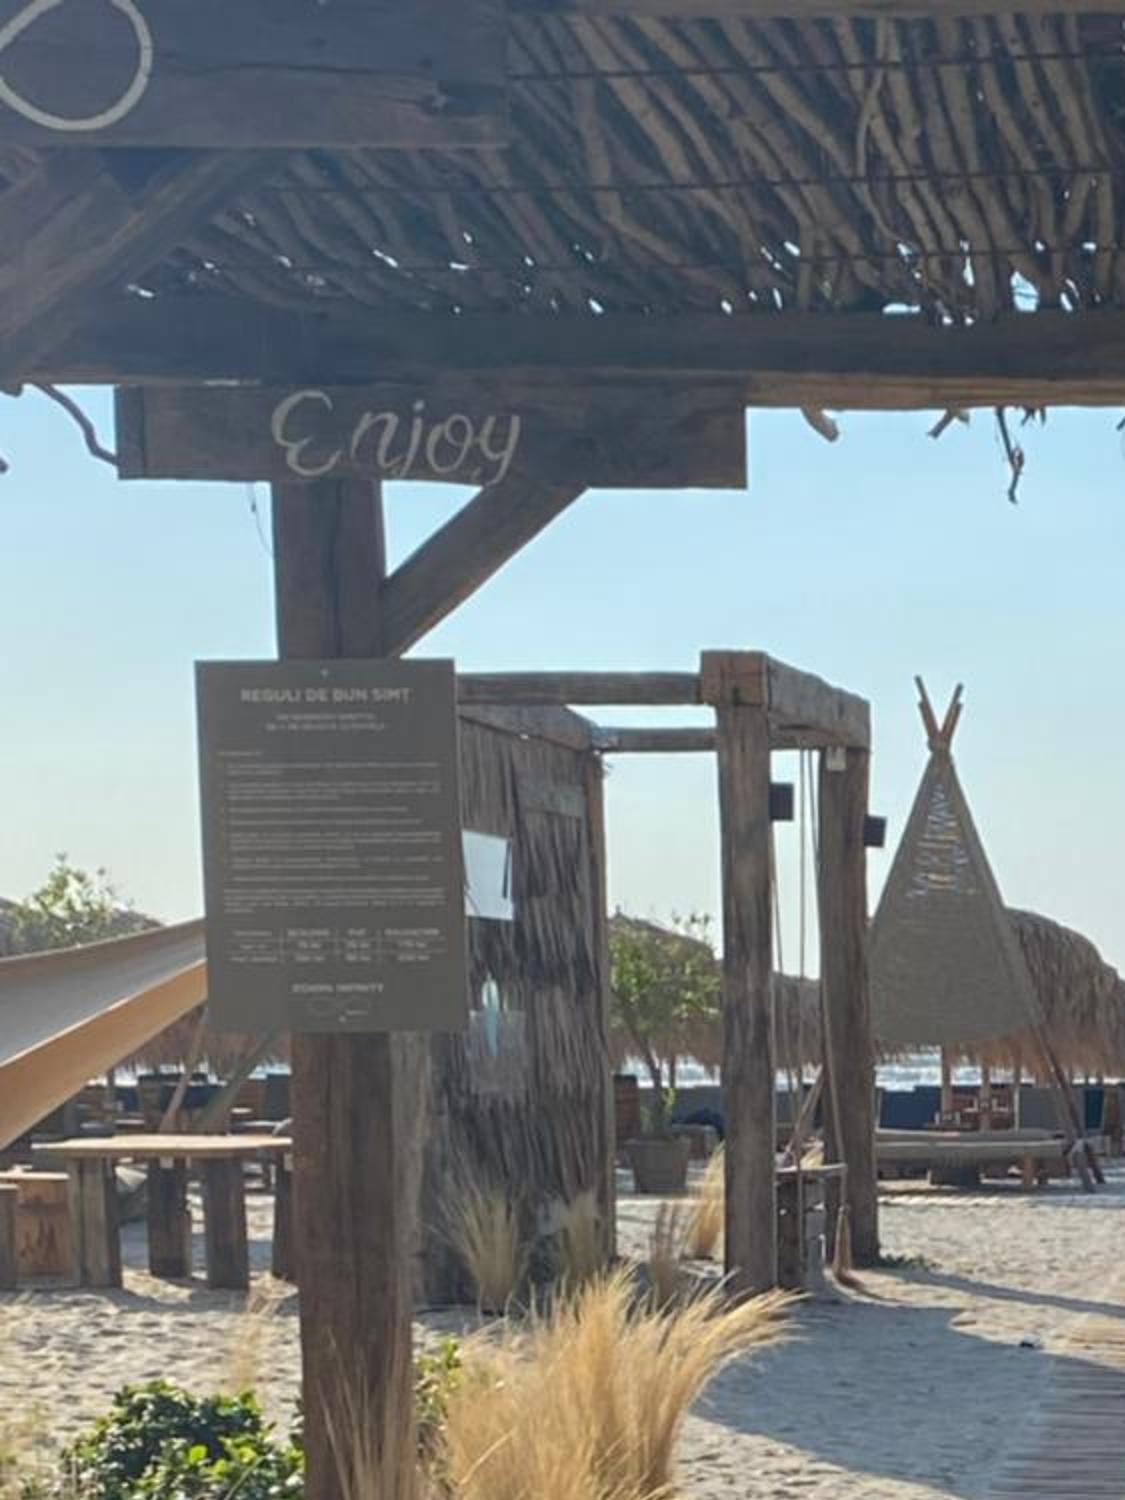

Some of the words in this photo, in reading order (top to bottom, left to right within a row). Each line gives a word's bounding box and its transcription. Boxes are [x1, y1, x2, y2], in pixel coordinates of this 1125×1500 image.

[271, 389, 520, 486] Enjoy
[240, 687, 300, 703] REGULI
[305, 687, 327, 703] DE
[333, 687, 368, 703] BUN
